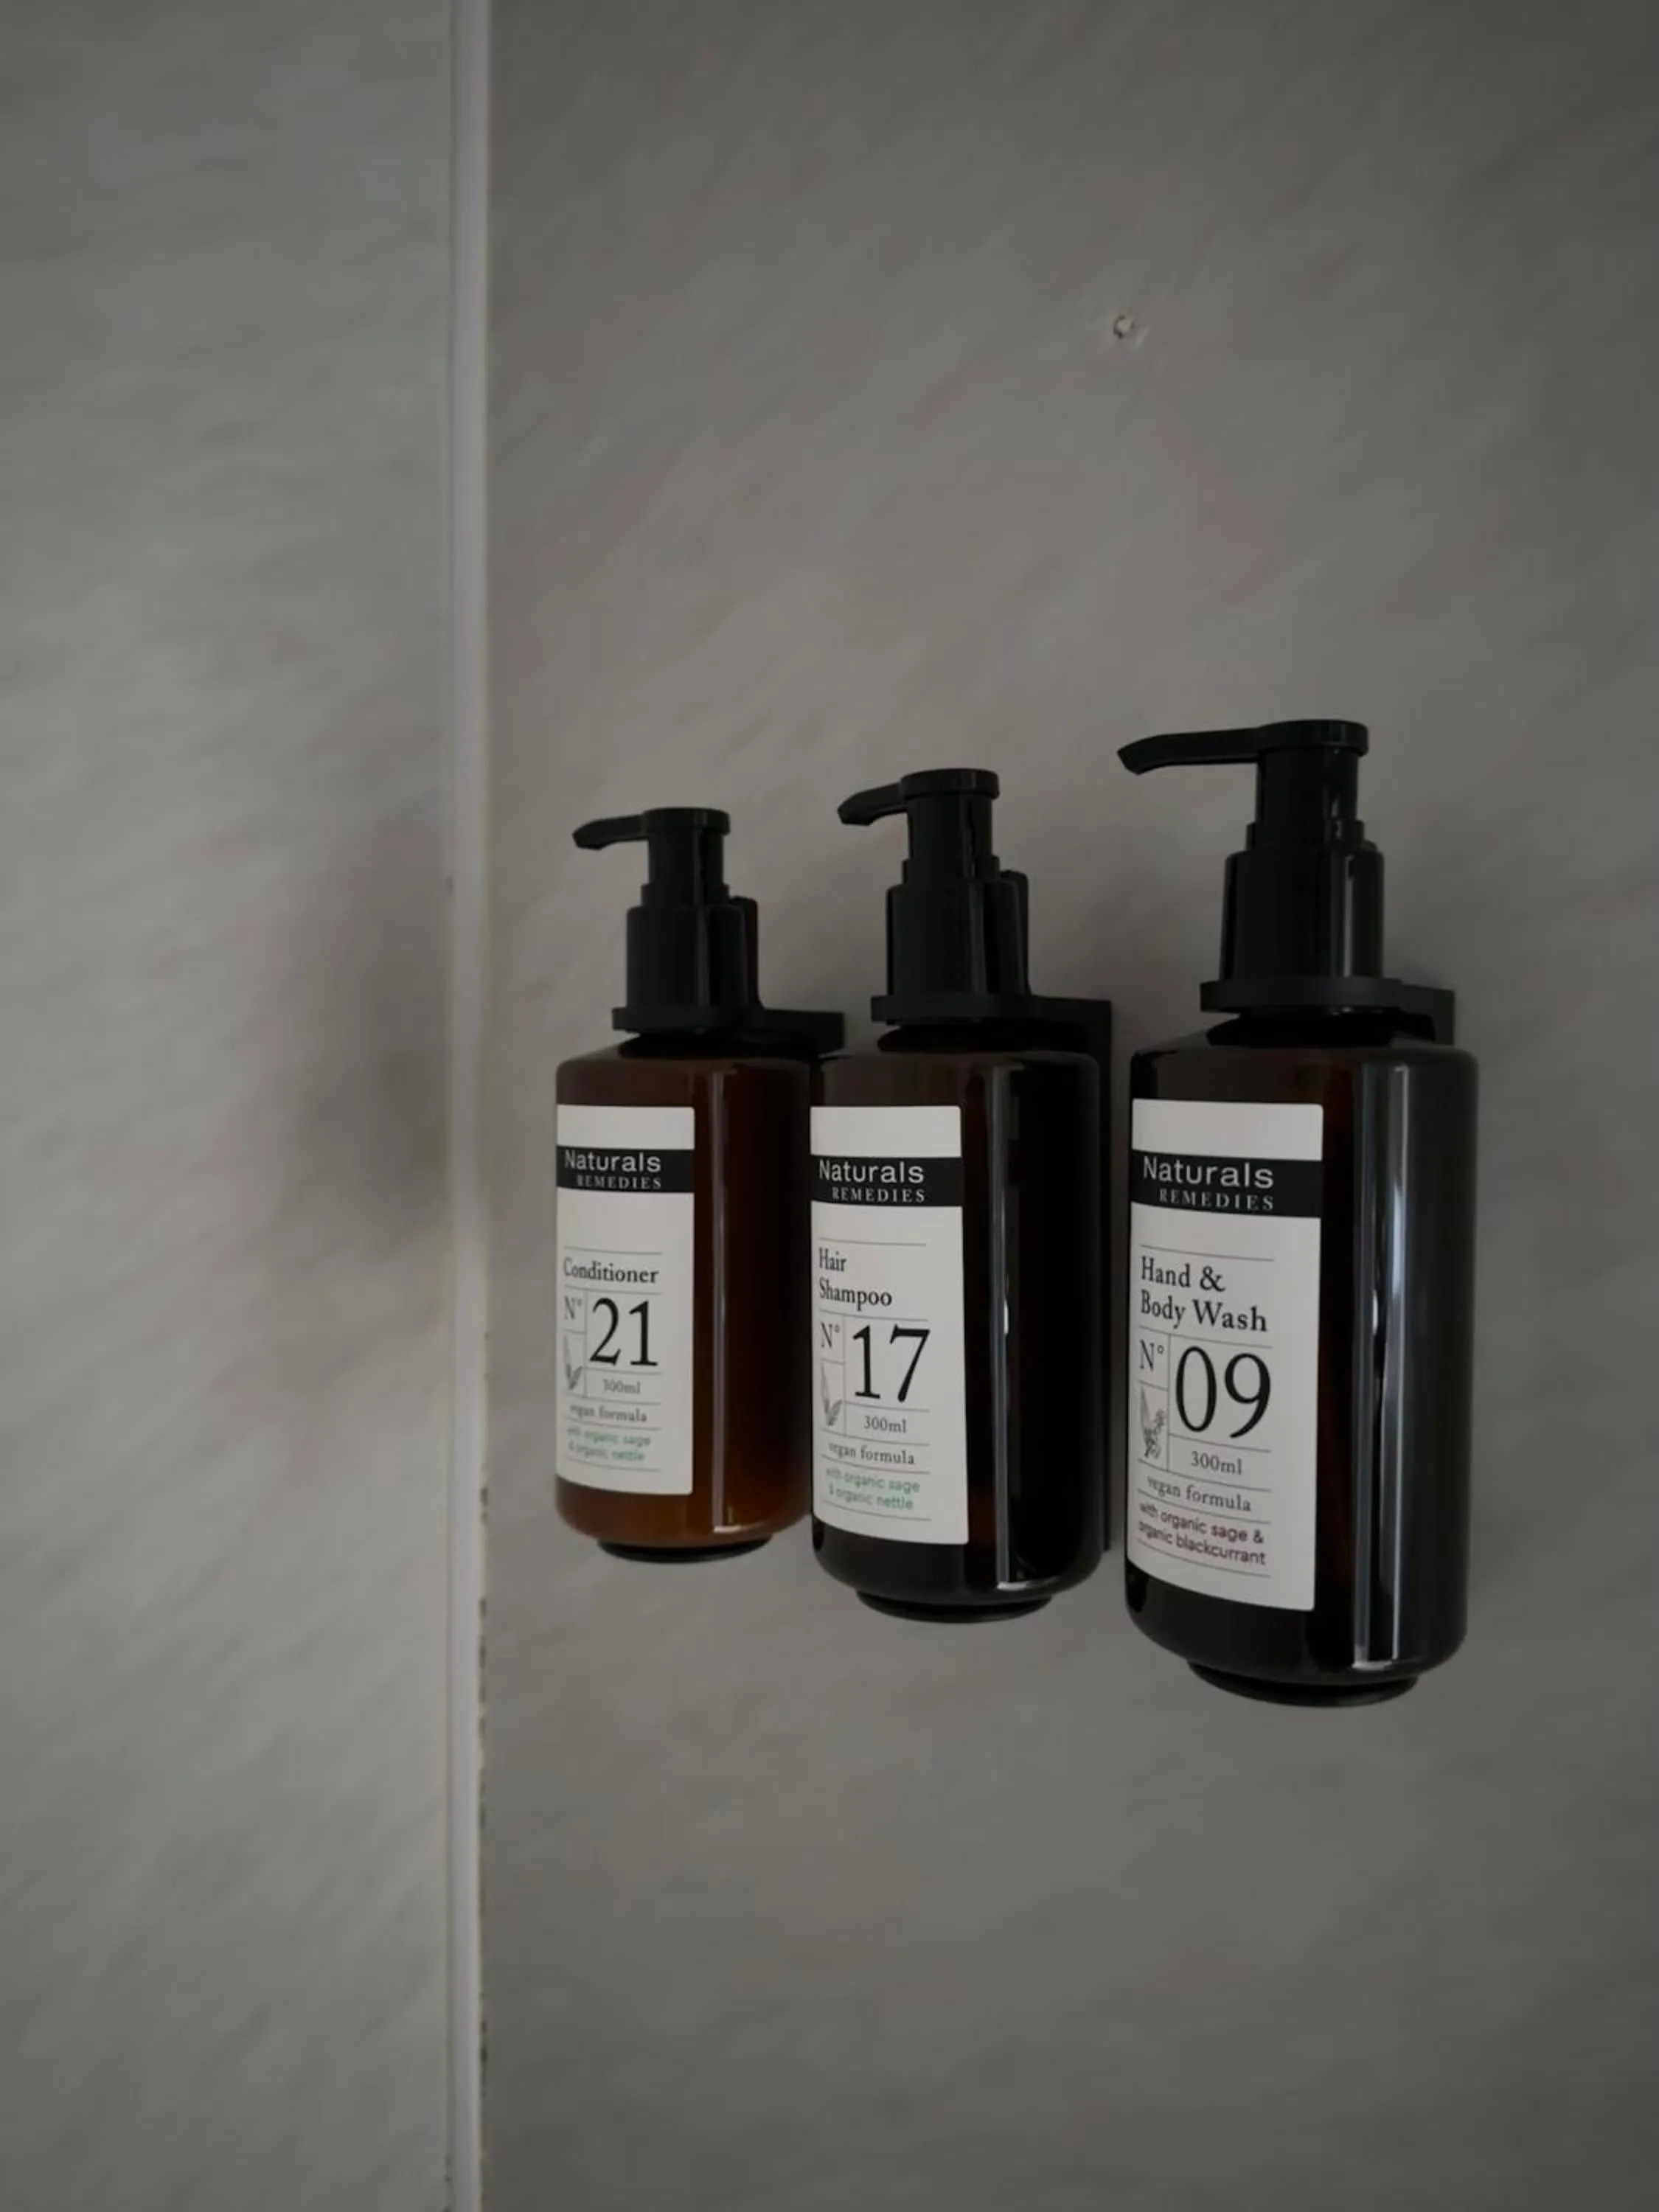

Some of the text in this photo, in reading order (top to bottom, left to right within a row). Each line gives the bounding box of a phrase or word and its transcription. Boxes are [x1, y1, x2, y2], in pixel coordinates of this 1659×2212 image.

[564, 1150, 661, 1172] Naturals
[818, 1158, 924, 1184] Naturals
[1144, 1155, 1273, 1189] Naturals
[577, 1175, 661, 1190] REMEDIES
[832, 1187, 925, 1203] REMEDIES
[1159, 1189, 1274, 1211] REMEDIES
[563, 1256, 659, 1283] Conditioner
[818, 1247, 846, 1272] Hair
[1141, 1256, 1225, 1292] Hand &
[818, 1276, 893, 1312] Shampoo
[1141, 1289, 1267, 1332] Body Wash
[588, 1297, 658, 1366] 21
[853, 1324, 931, 1402] 17
[1176, 1346, 1270, 1439] 09
[599, 1404, 647, 1422] formula
[863, 1415, 907, 1433] 300ml
[860, 1445, 915, 1465] formula
[1191, 1450, 1242, 1475] 300ml
[844, 1472, 886, 1488] organic
[888, 1480, 920, 1495] sage
[1147, 1476, 1251, 1512] vegan formula
[877, 1495, 914, 1510] nettle
[1140, 1502, 1264, 1544] with organic sage &
[1138, 1520, 1266, 1565] organic blackcurrant
